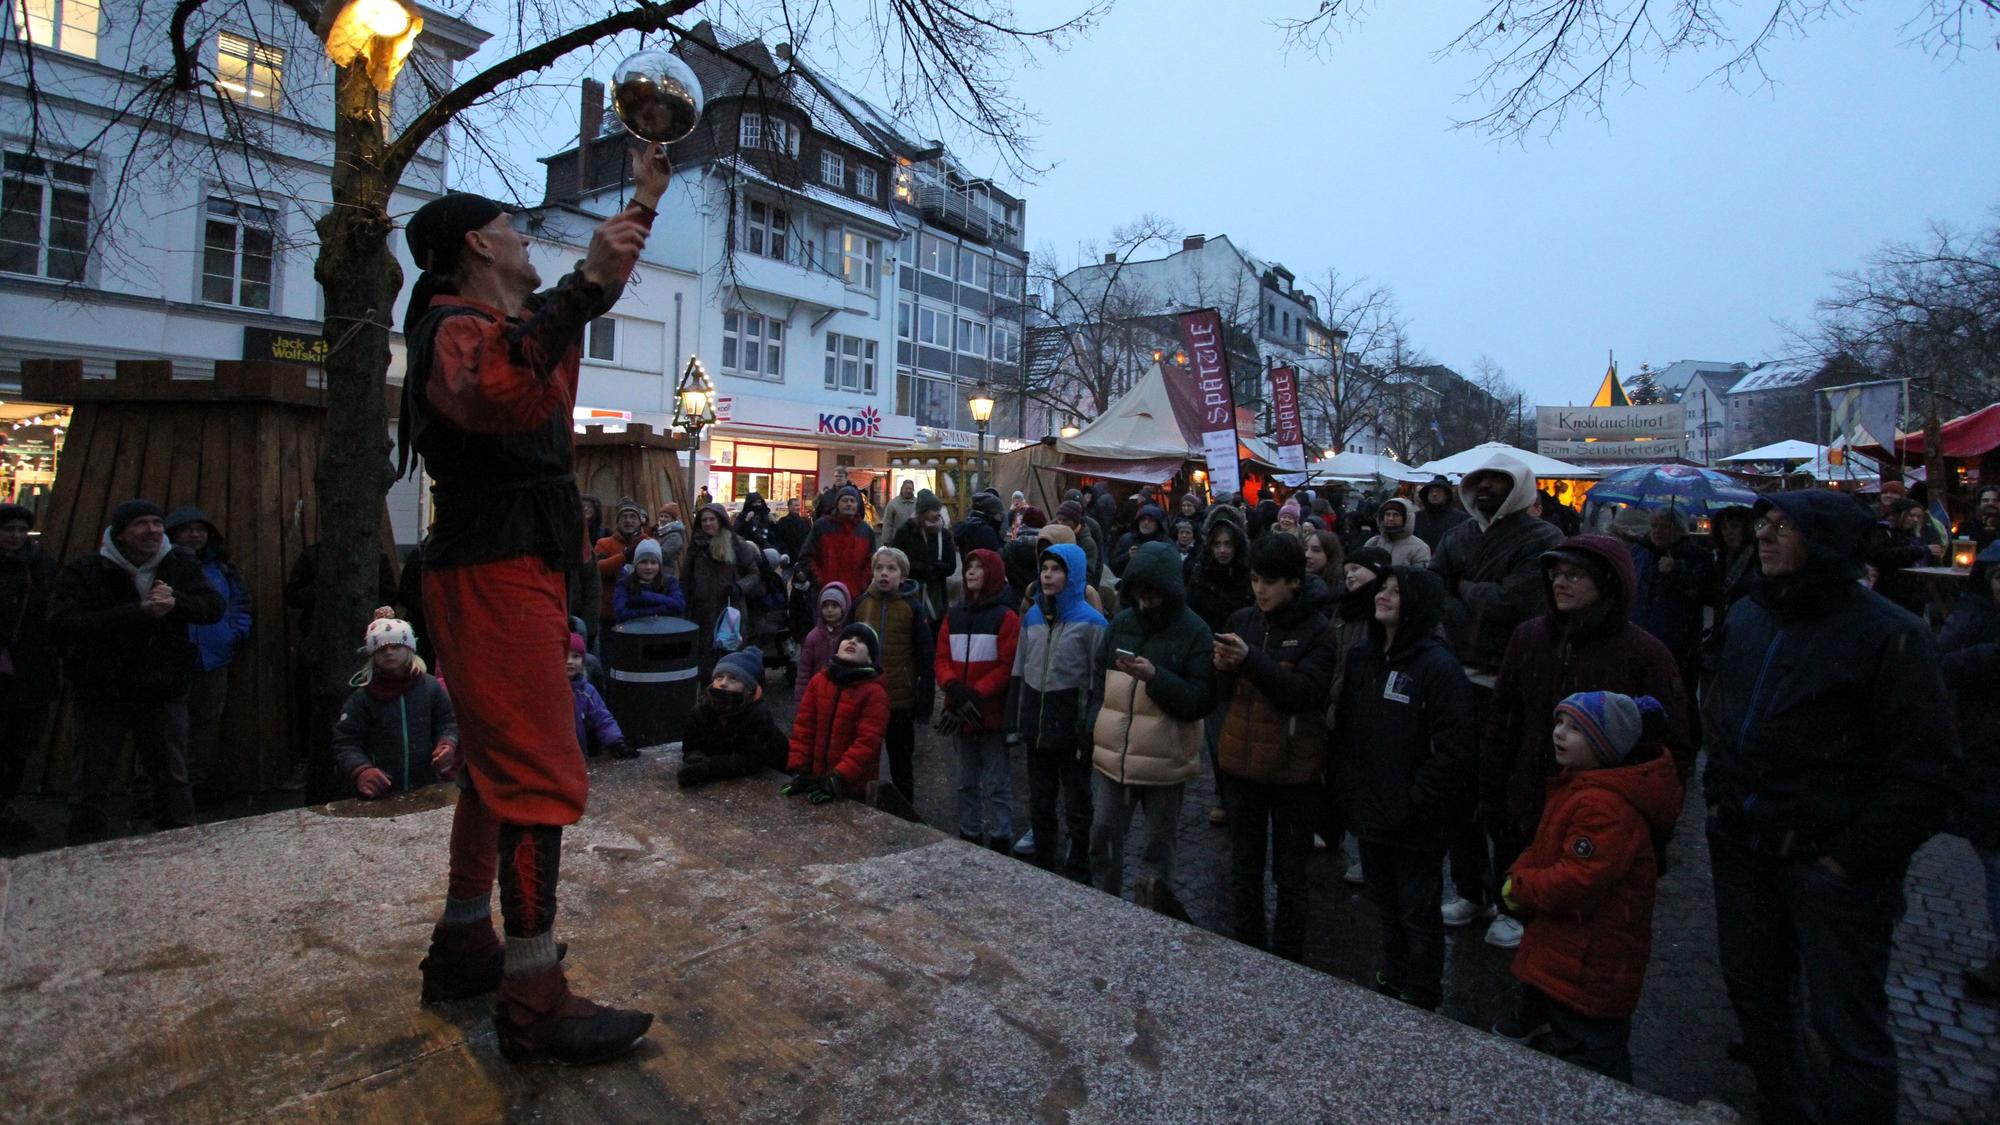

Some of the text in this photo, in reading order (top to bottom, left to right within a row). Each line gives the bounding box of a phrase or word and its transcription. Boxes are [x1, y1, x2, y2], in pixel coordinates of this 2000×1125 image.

[272, 336, 305, 349] Jack
[1559, 412, 1663, 431] Knoblauchbrot
[1543, 446, 1569, 454] zum
